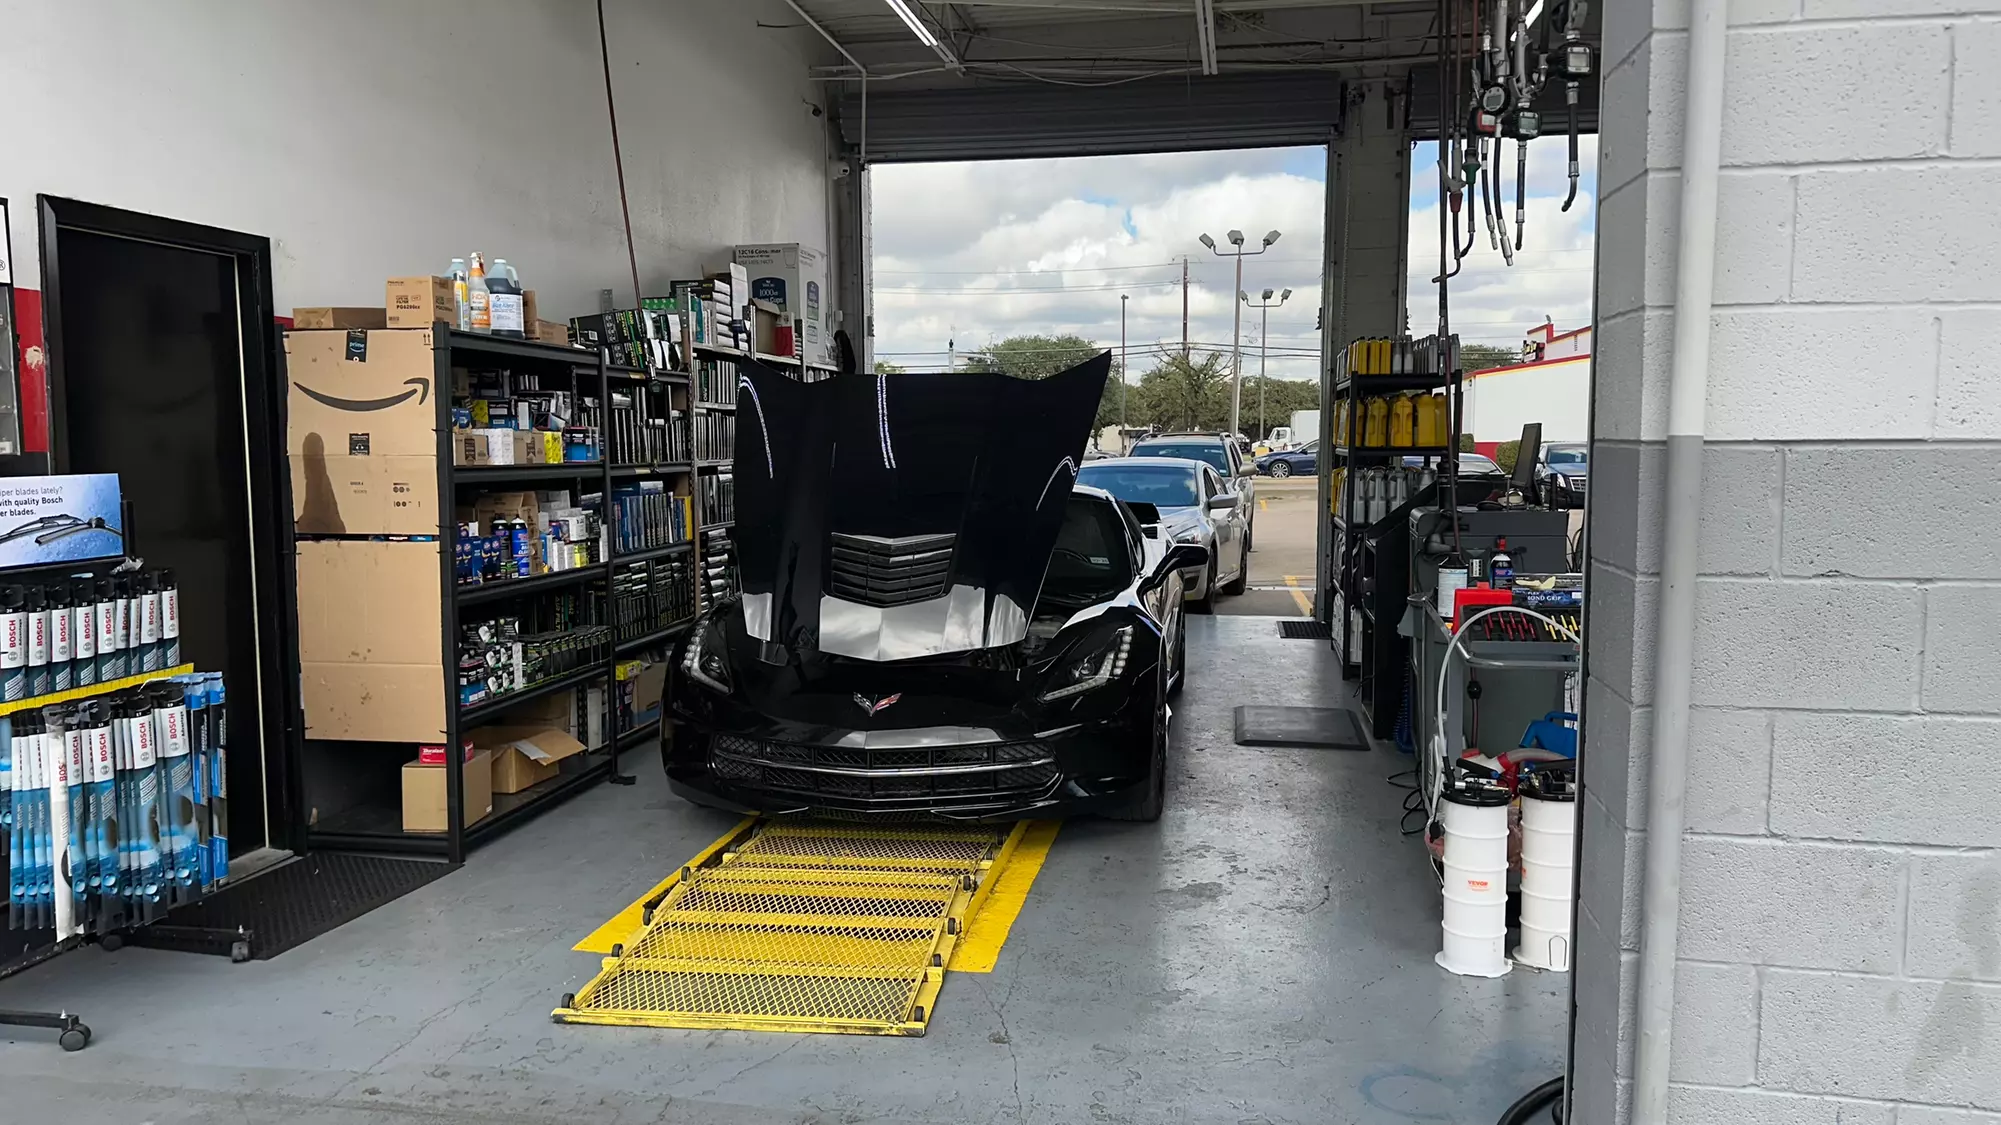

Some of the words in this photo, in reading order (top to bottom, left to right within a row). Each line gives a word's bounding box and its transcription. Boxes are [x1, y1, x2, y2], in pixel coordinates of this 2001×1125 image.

[14, 498, 40, 507] quality
[41, 496, 64, 504] Bosch
[15, 488, 39, 496] blades
[40, 485, 63, 495] lately?
[9, 508, 37, 516] blades.
[138, 722, 147, 749] BOSCH
[168, 713, 178, 739] BOSCH
[72, 735, 80, 765] BOSCH
[99, 733, 107, 762] BOSCH
